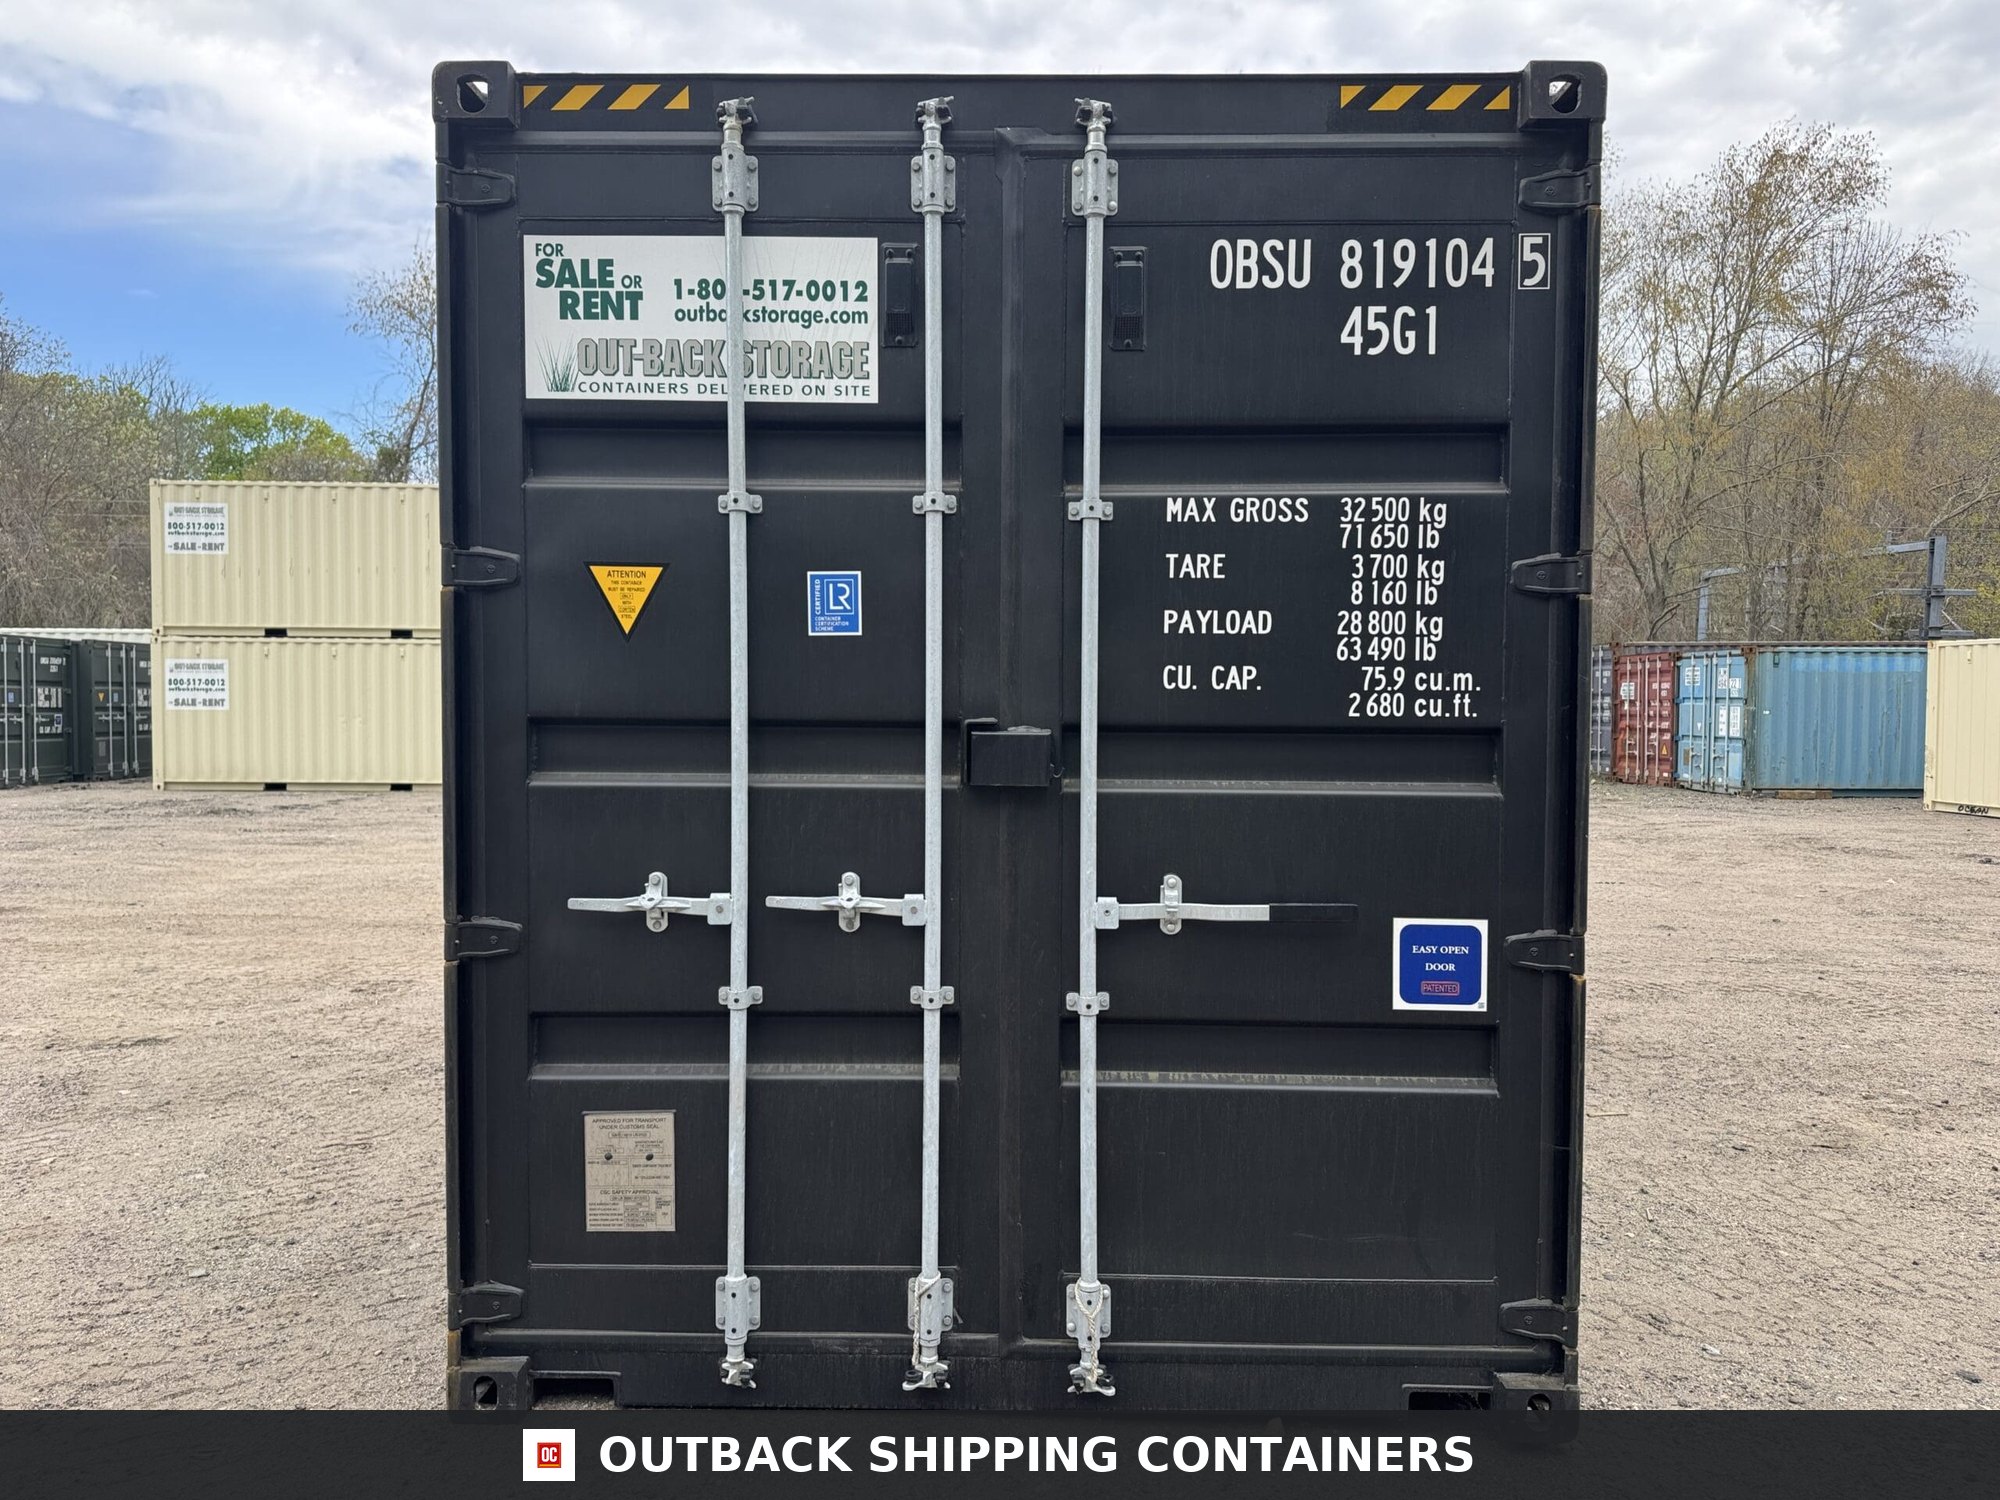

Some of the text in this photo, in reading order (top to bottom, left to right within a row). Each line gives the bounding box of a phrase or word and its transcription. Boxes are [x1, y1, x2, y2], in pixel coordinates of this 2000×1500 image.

[535, 243, 564, 257] FOR
[535, 258, 642, 289] SALE OR
[1210, 237, 1546, 289] OBSU 819104 5
[674, 278, 868, 302] 1-80-517-0012
[559, 291, 644, 320] RENT
[674, 301, 868, 329] outbakstorage.com
[1340, 306, 1437, 356] 45G1
[577, 338, 728, 378] OUT-BACK
[578, 381, 871, 397] CONTAINERS DELERED ON SITE
[1166, 497, 1216, 522] MAX
[1230, 498, 1309, 522] GROSS
[1418, 498, 1447, 528] kg
[174, 542, 197, 550] SALE
[202, 542, 224, 551] RENT
[1418, 524, 1440, 549] lb
[606, 570, 646, 578] ATTENTION
[1166, 554, 1226, 578] TARE
[1417, 554, 1445, 585] kg
[828, 583, 852, 610] LR
[1416, 581, 1438, 606] lb
[1163, 610, 1273, 634] PAYLOAD
[1415, 611, 1443, 642] kg
[1414, 637, 1436, 662] lb
[1163, 665, 1482, 692] CU. CAP. 75.9 cu.m.
[174, 698, 197, 706] SALE
[202, 698, 226, 707] RENT
[1414, 692, 1478, 718] cu.ft.
[1412, 945, 1470, 954] EASY OPEN
[1425, 963, 1456, 972] DOOR
[1423, 984, 1458, 992] PATENTED
